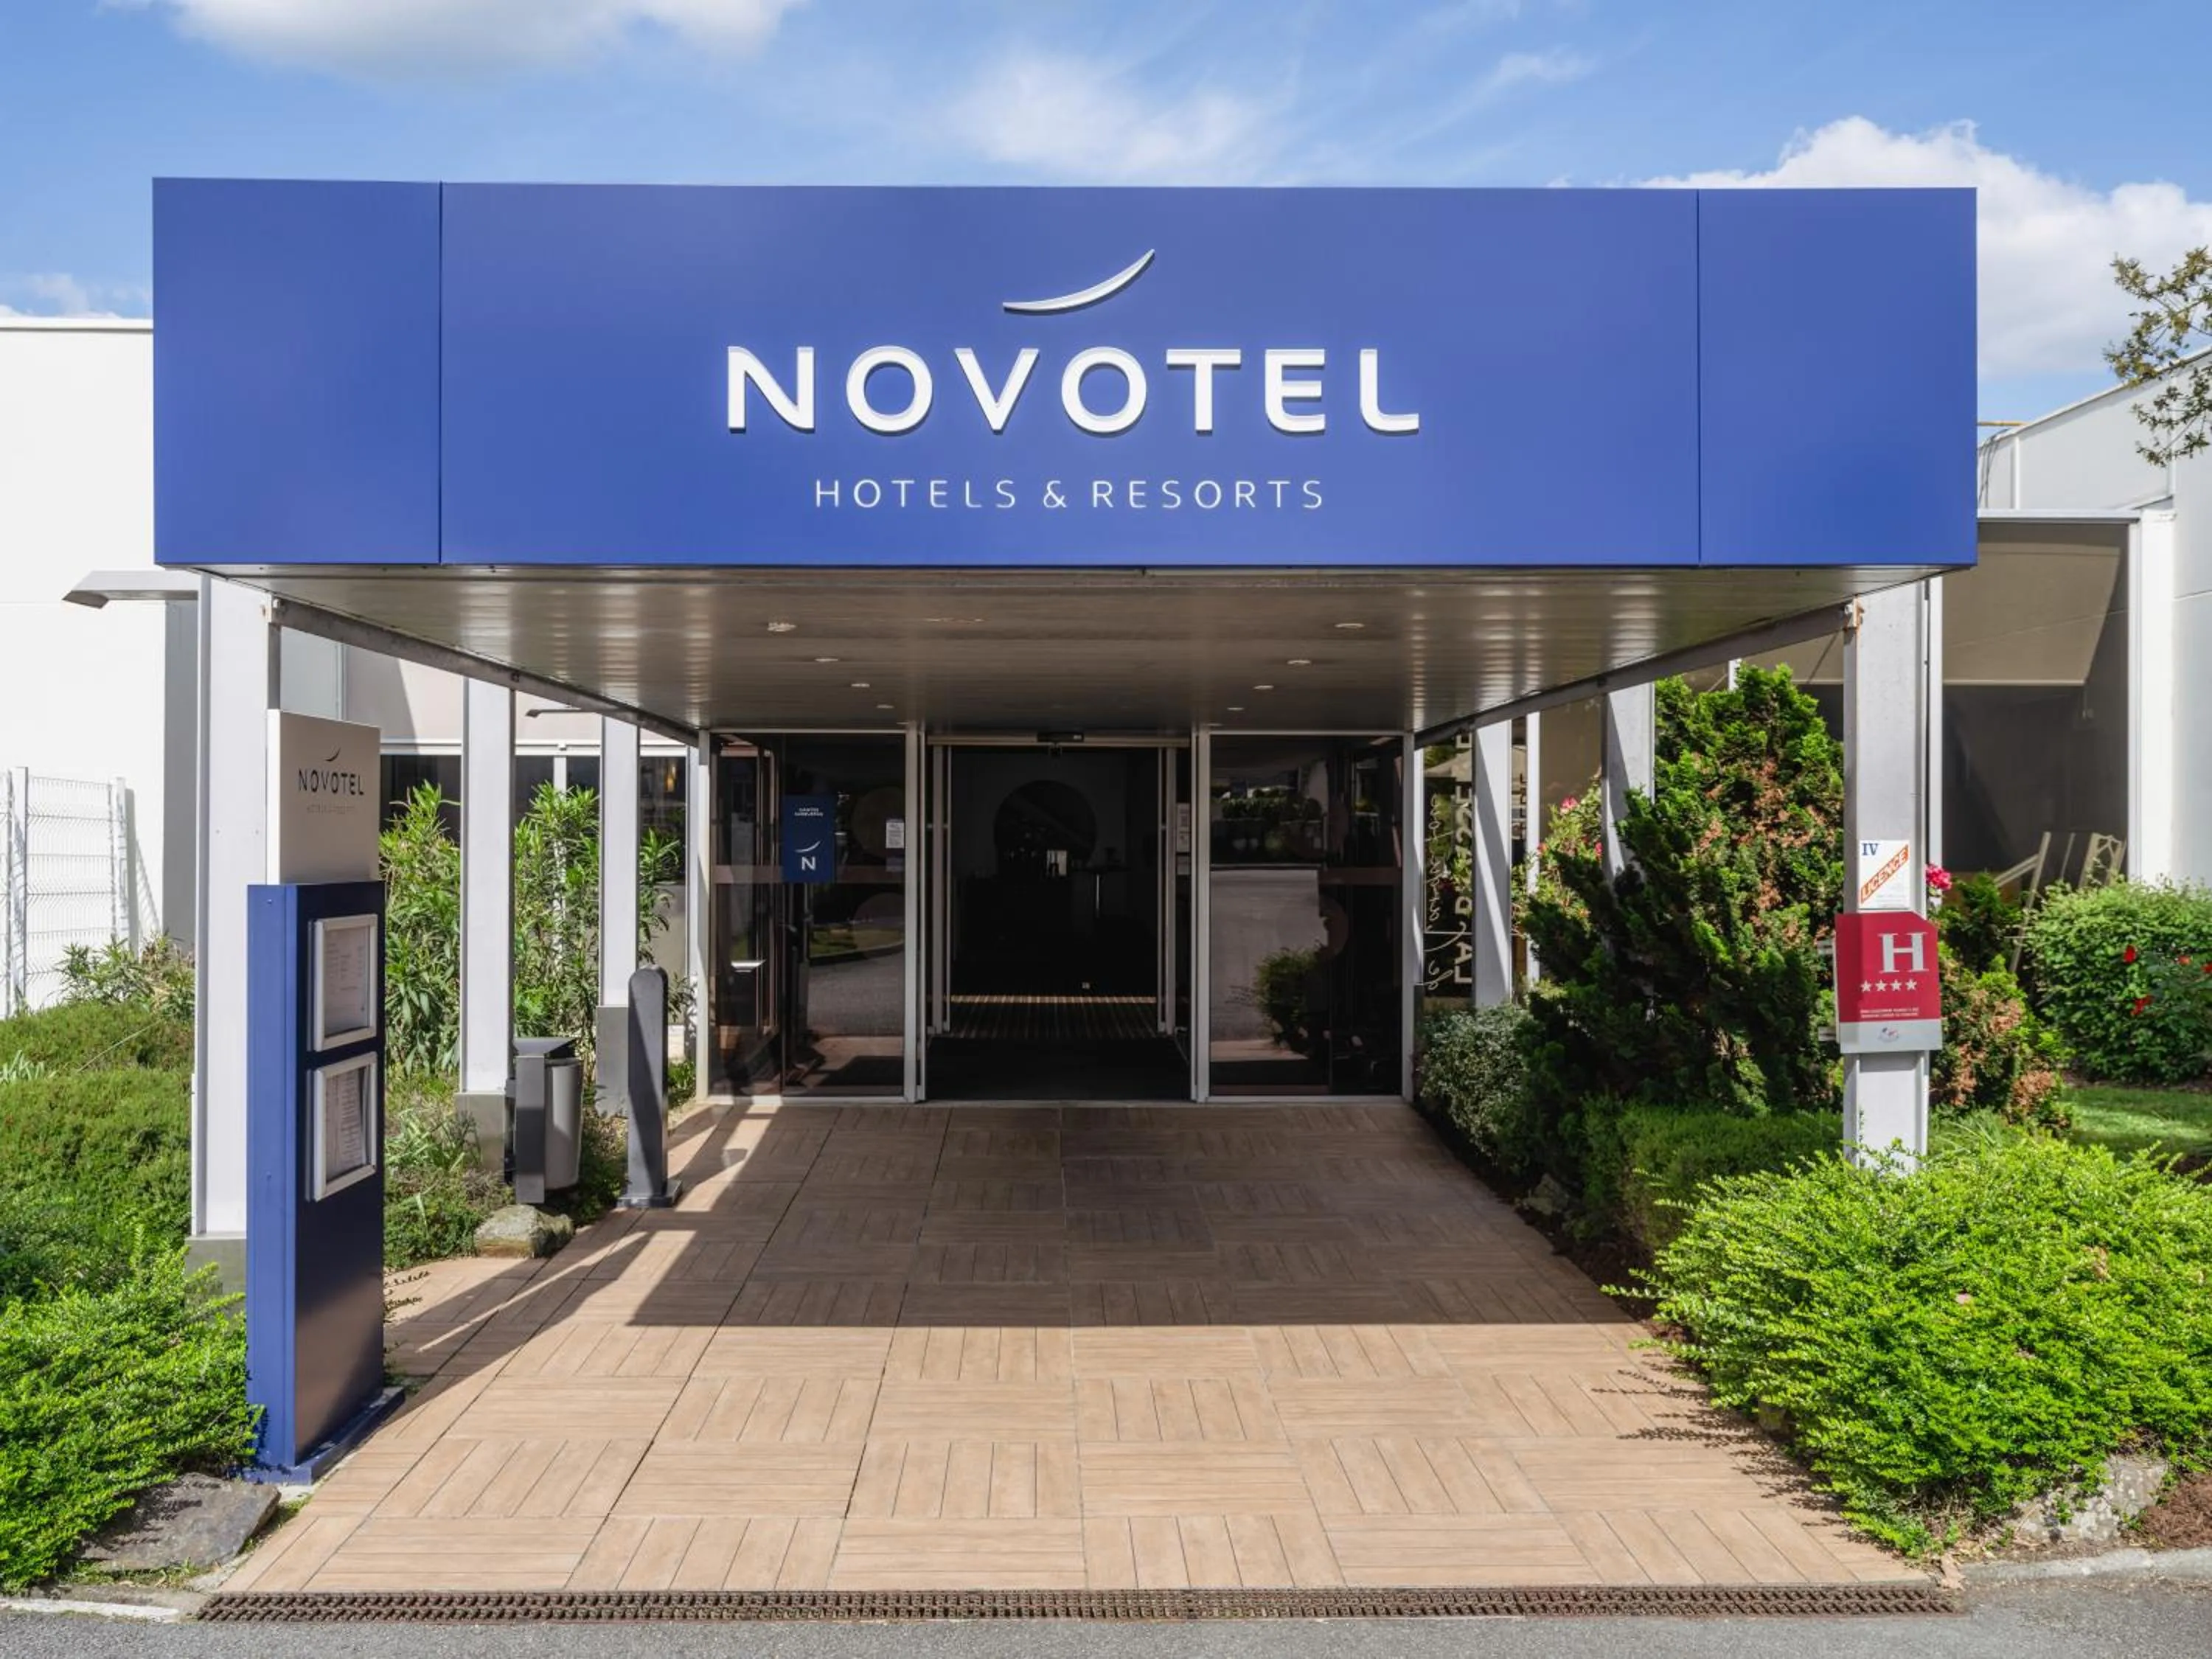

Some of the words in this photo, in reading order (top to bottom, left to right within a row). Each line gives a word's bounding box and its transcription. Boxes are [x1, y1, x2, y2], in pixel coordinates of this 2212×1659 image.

[727, 346, 1419, 434] NOVOTEL
[815, 479, 1016, 509] HOTELS
[1043, 479, 1068, 509] &
[1092, 479, 1324, 509] RESORTS
[298, 770, 364, 796] NOVOTEL
[801, 856, 816, 871] N
[1862, 843, 1879, 856] IV
[1862, 847, 1909, 900] LICENCE
[1878, 932, 1930, 973] H
